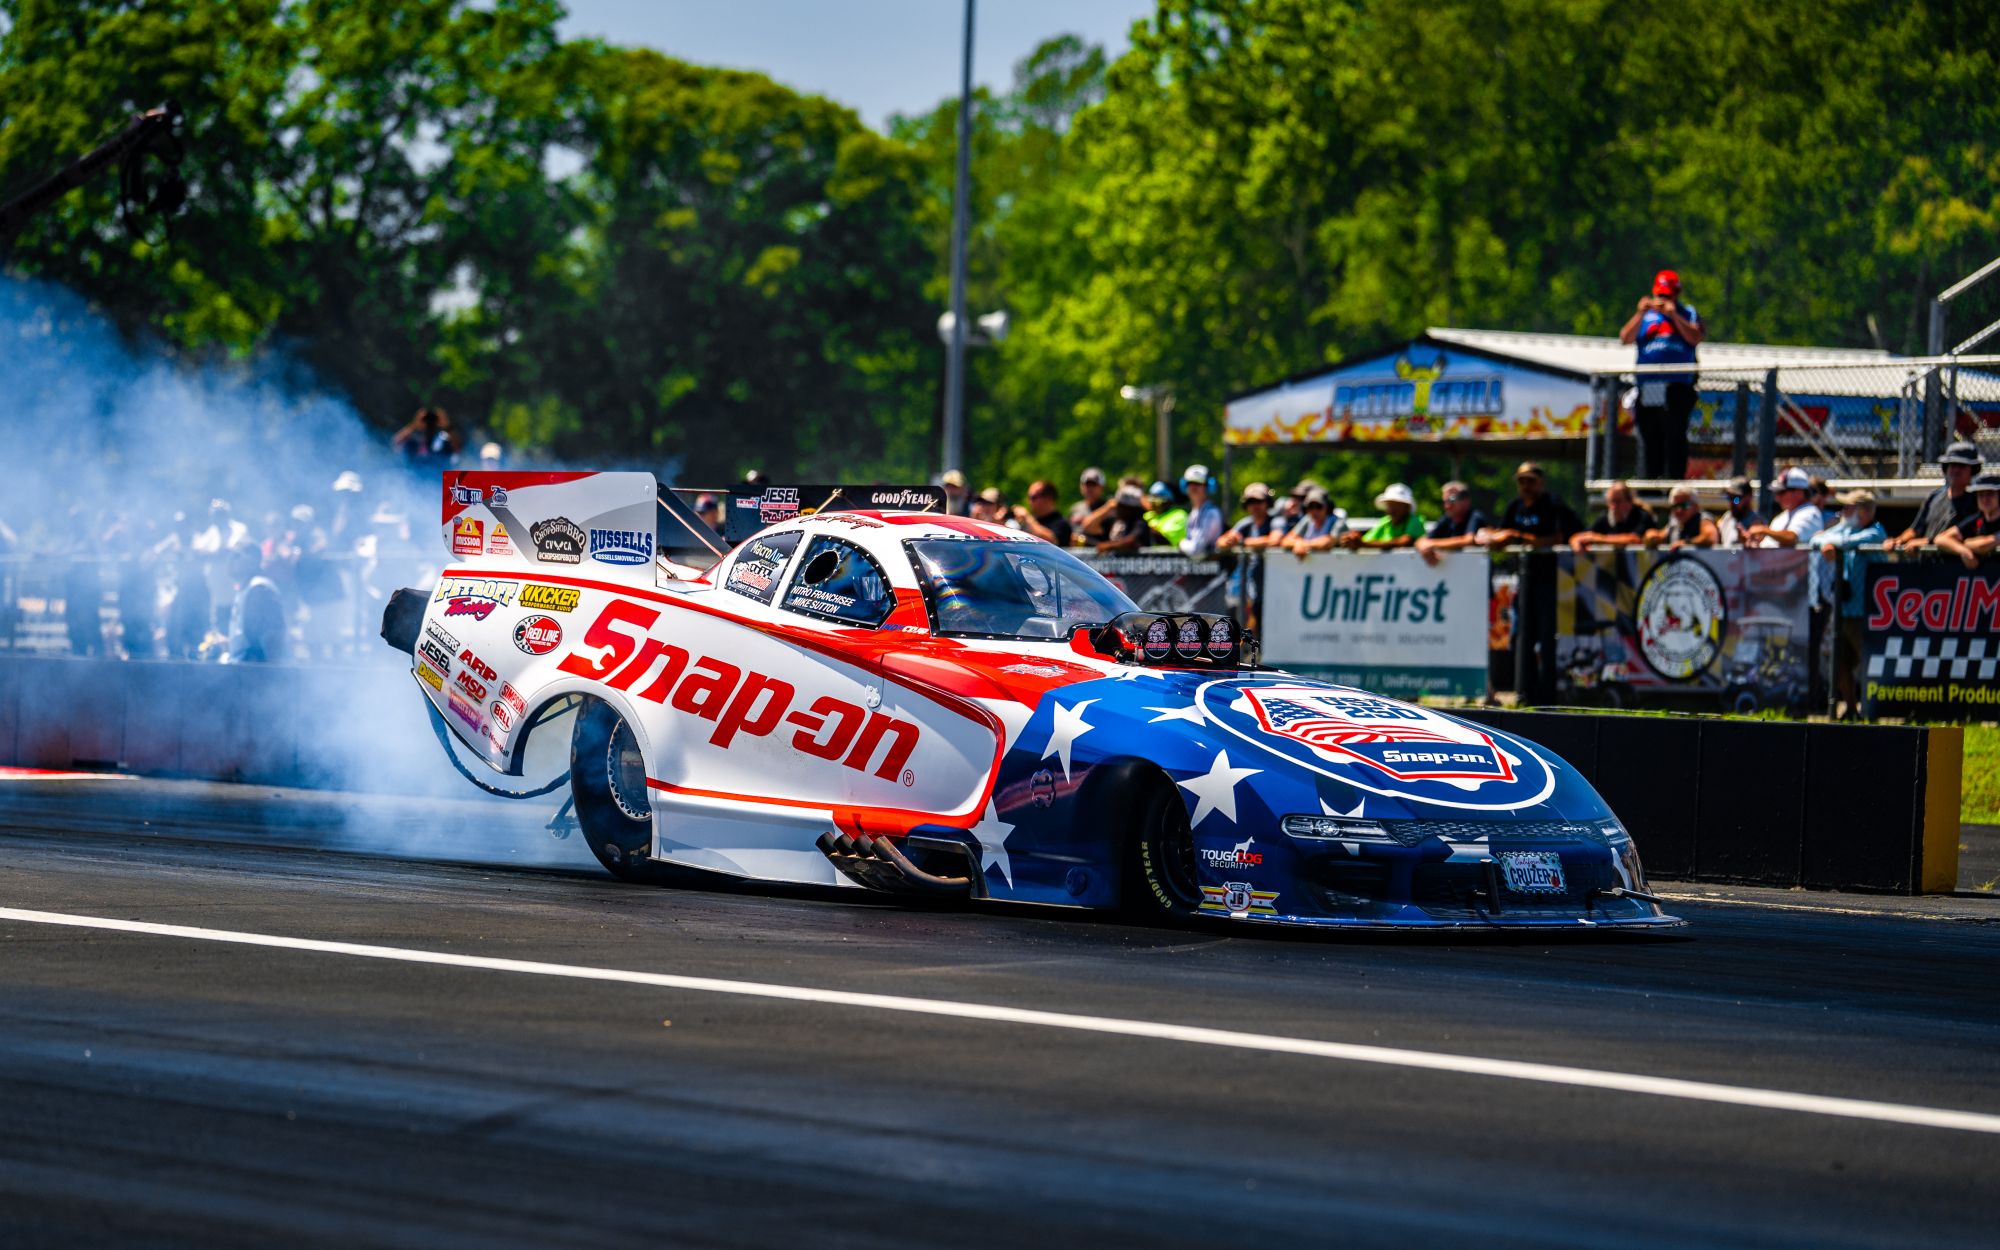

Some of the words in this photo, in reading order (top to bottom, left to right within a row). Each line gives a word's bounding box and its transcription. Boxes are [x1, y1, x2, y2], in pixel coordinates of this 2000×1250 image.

[761, 488, 799, 503] JESEL
[545, 540, 553, 549] CV
[564, 541, 572, 551] CA
[590, 529, 653, 557] RUSSELLS
[595, 553, 646, 564] RUSSELLSMOVING.COM
[435, 578, 519, 606] PETROFF
[530, 585, 579, 608] KICKER
[791, 586, 812, 597] NITRO
[812, 588, 856, 607] FRANCHISEE
[1300, 573, 1448, 623] UniFirst
[521, 601, 556, 611] PERFORMANCE
[792, 597, 811, 609] MIKE
[811, 601, 840, 614] SUTTON
[427, 619, 460, 651] MOTHERS
[527, 627, 542, 639] RED
[542, 629, 560, 642] LINE
[420, 640, 451, 673] JESEL
[459, 649, 497, 681] ARP
[457, 670, 487, 699] MSD
[557, 599, 920, 782] Snap-on
[1866, 681, 1943, 702] Pavement
[501, 684, 525, 714] SIMPSON
[494, 703, 510, 728] BELL
[1336, 706, 1428, 721] 250
[1237, 851, 1263, 865] DOG
[1510, 867, 1550, 885] CRUZER
